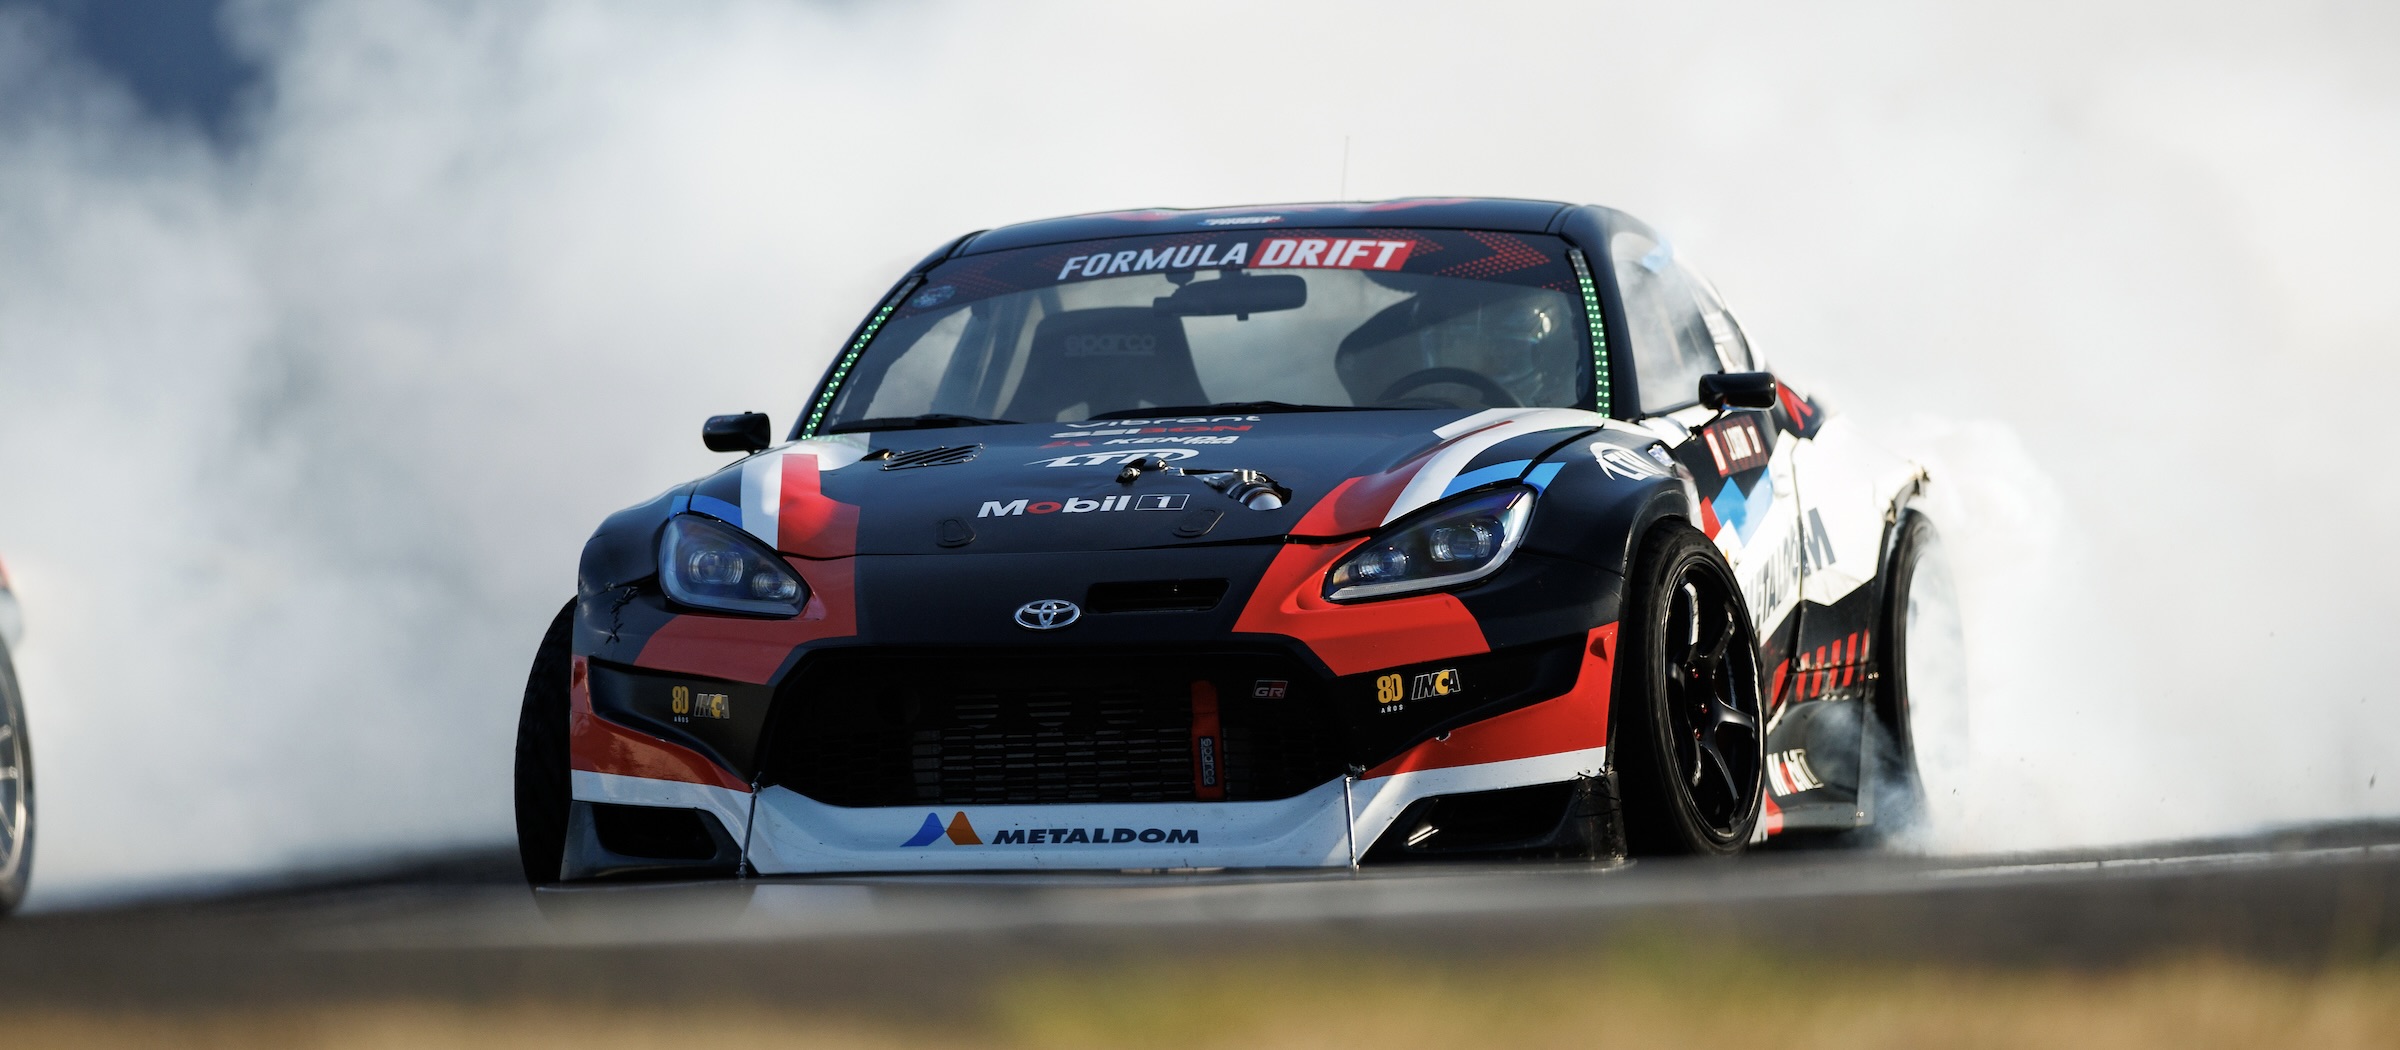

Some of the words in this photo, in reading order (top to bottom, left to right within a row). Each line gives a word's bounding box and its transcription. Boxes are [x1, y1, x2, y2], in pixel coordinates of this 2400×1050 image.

[1057, 242, 1249, 281] FORMULA
[1258, 239, 1407, 269] DRIFT
[1064, 333, 1156, 356] sparco
[1050, 425, 1253, 439] SEIBON
[1103, 435, 1240, 446] KENDA
[976, 494, 1133, 519] Mobil
[1254, 686, 1285, 698] GR
[1376, 673, 1404, 704] 80
[1411, 668, 1461, 700] IMCA
[671, 685, 689, 714] 80
[693, 693, 730, 719] IMCA
[1380, 703, 1404, 714] AÑOS
[1200, 737, 1216, 786] sparco
[991, 827, 1200, 845] METALDOM
